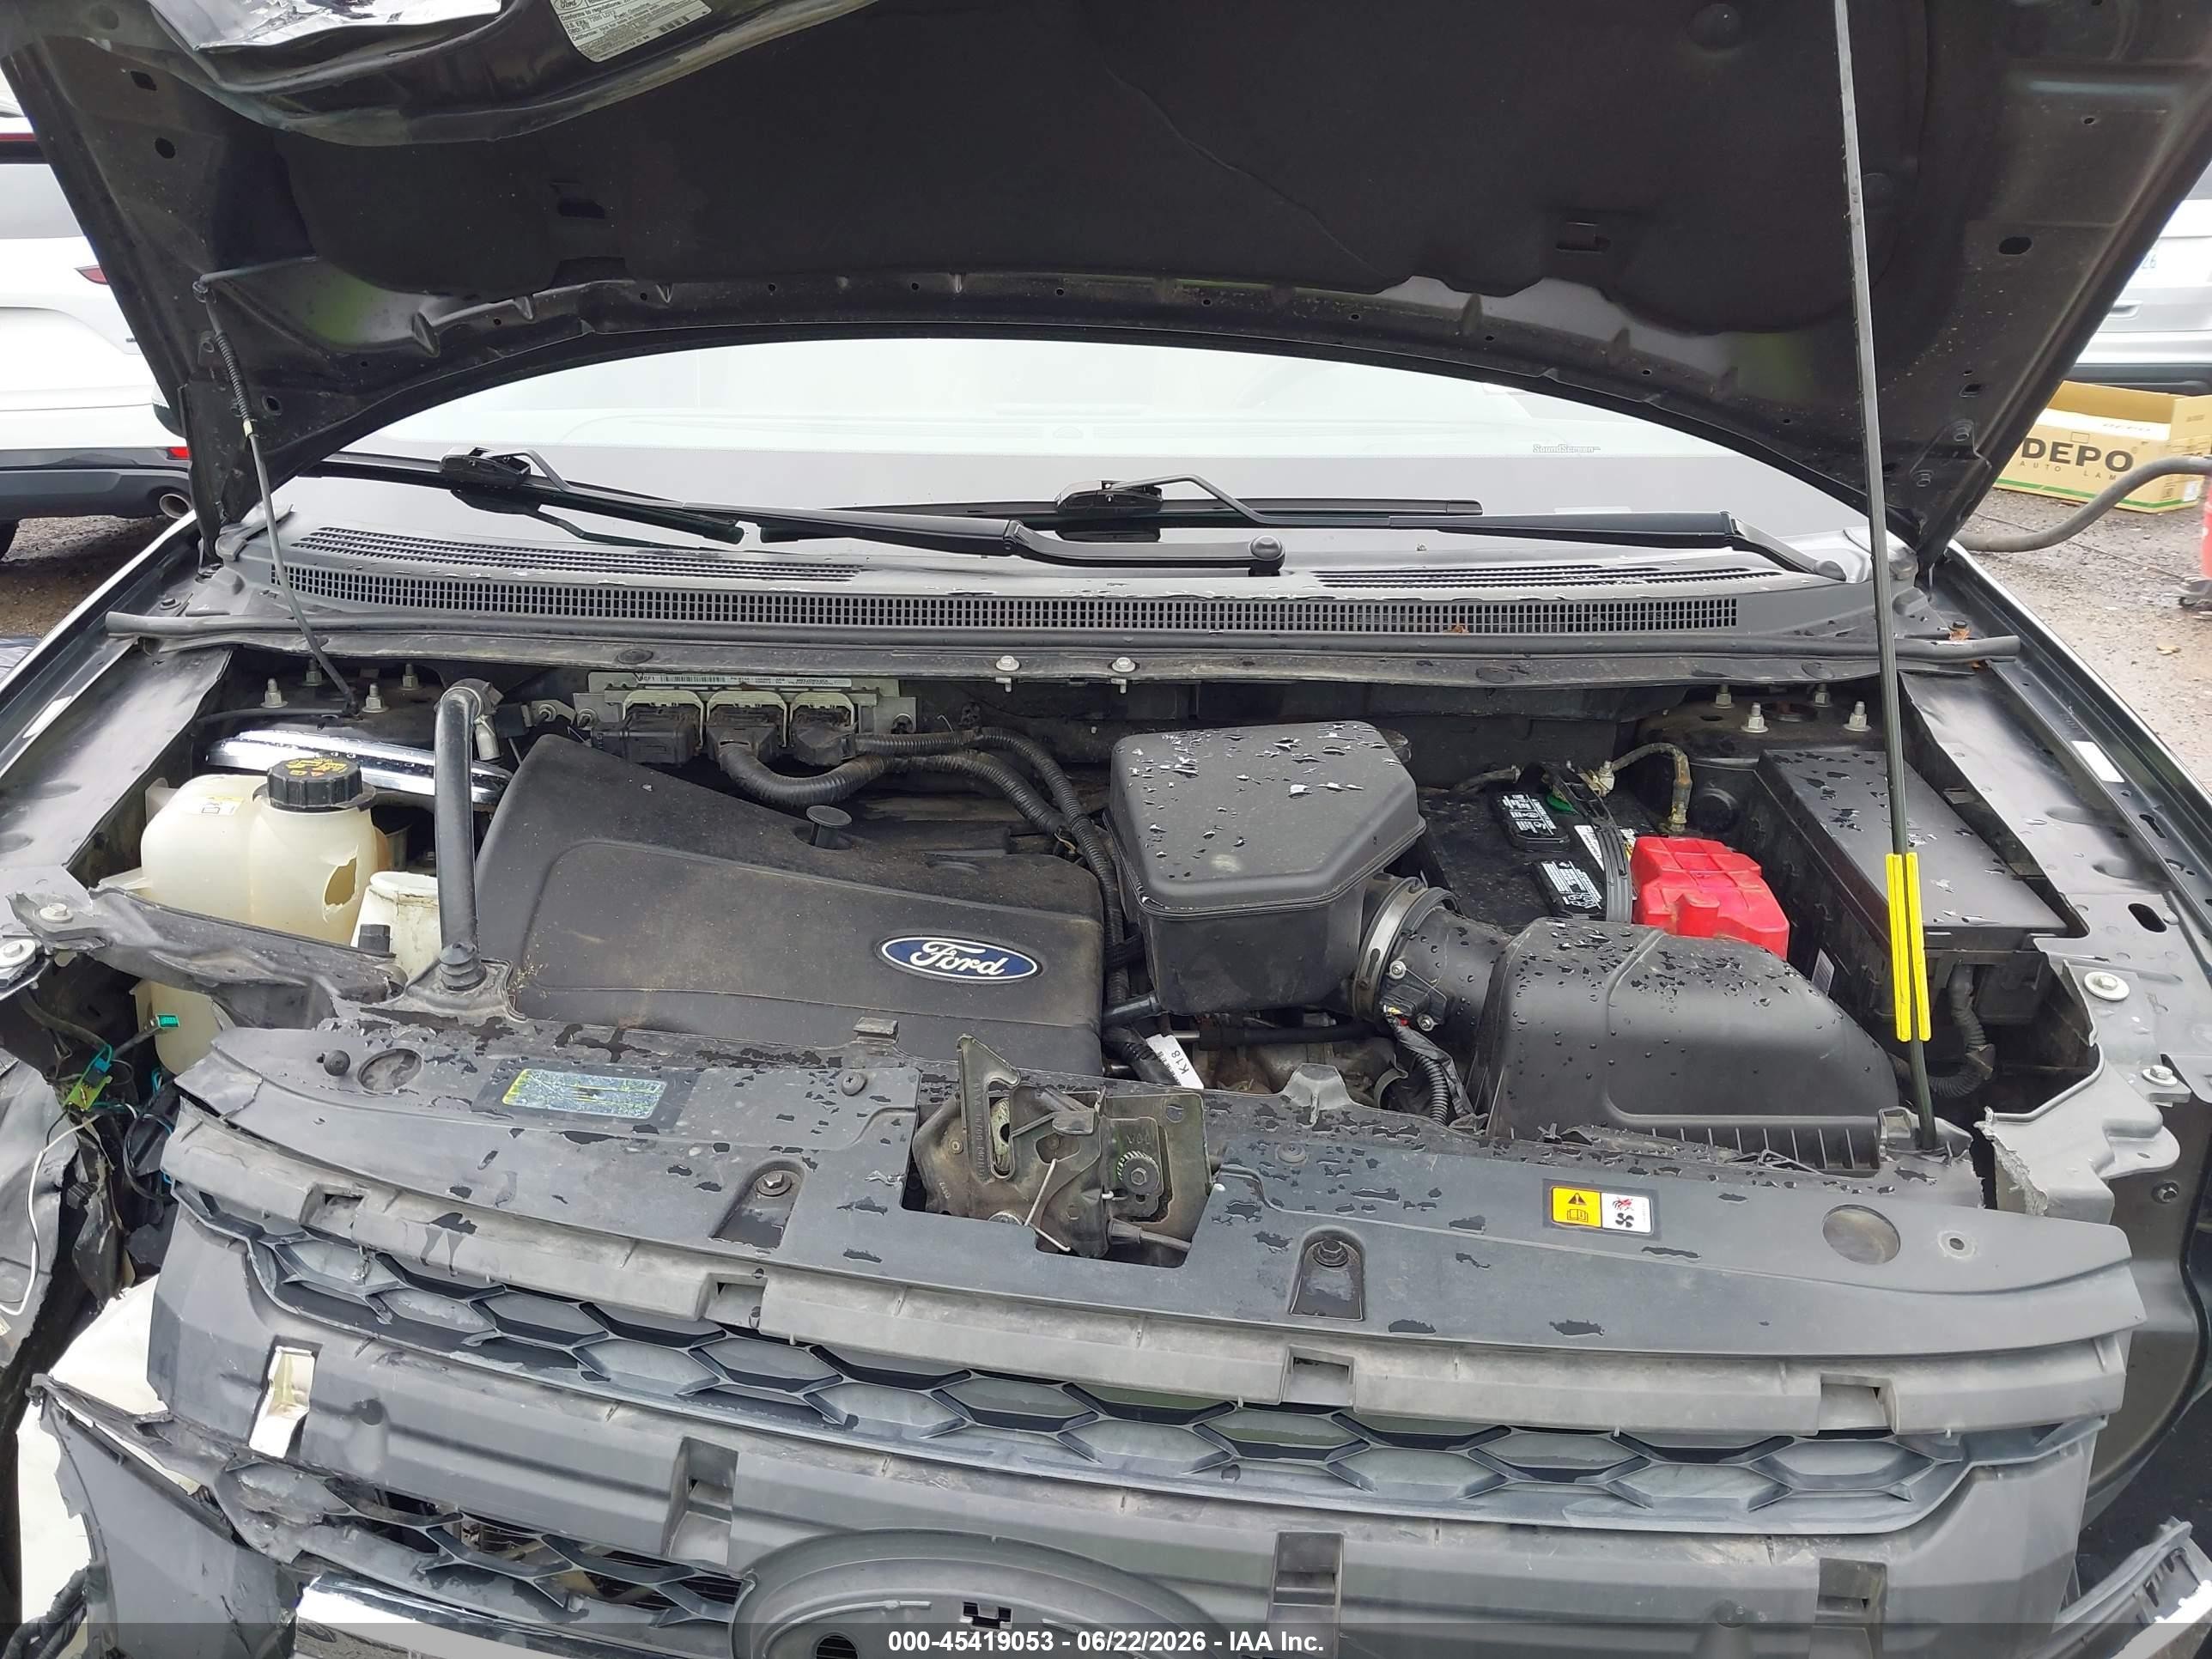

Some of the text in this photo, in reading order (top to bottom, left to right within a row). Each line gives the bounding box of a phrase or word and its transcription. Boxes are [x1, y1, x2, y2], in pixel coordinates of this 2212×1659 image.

[561, 12, 586, 21] Conforms
[2021, 438, 2134, 472] DEPO
[2020, 460, 2117, 481] AUTO LAM
[910, 941, 1009, 975] Ford
[1170, 1050, 1190, 1075] K18
